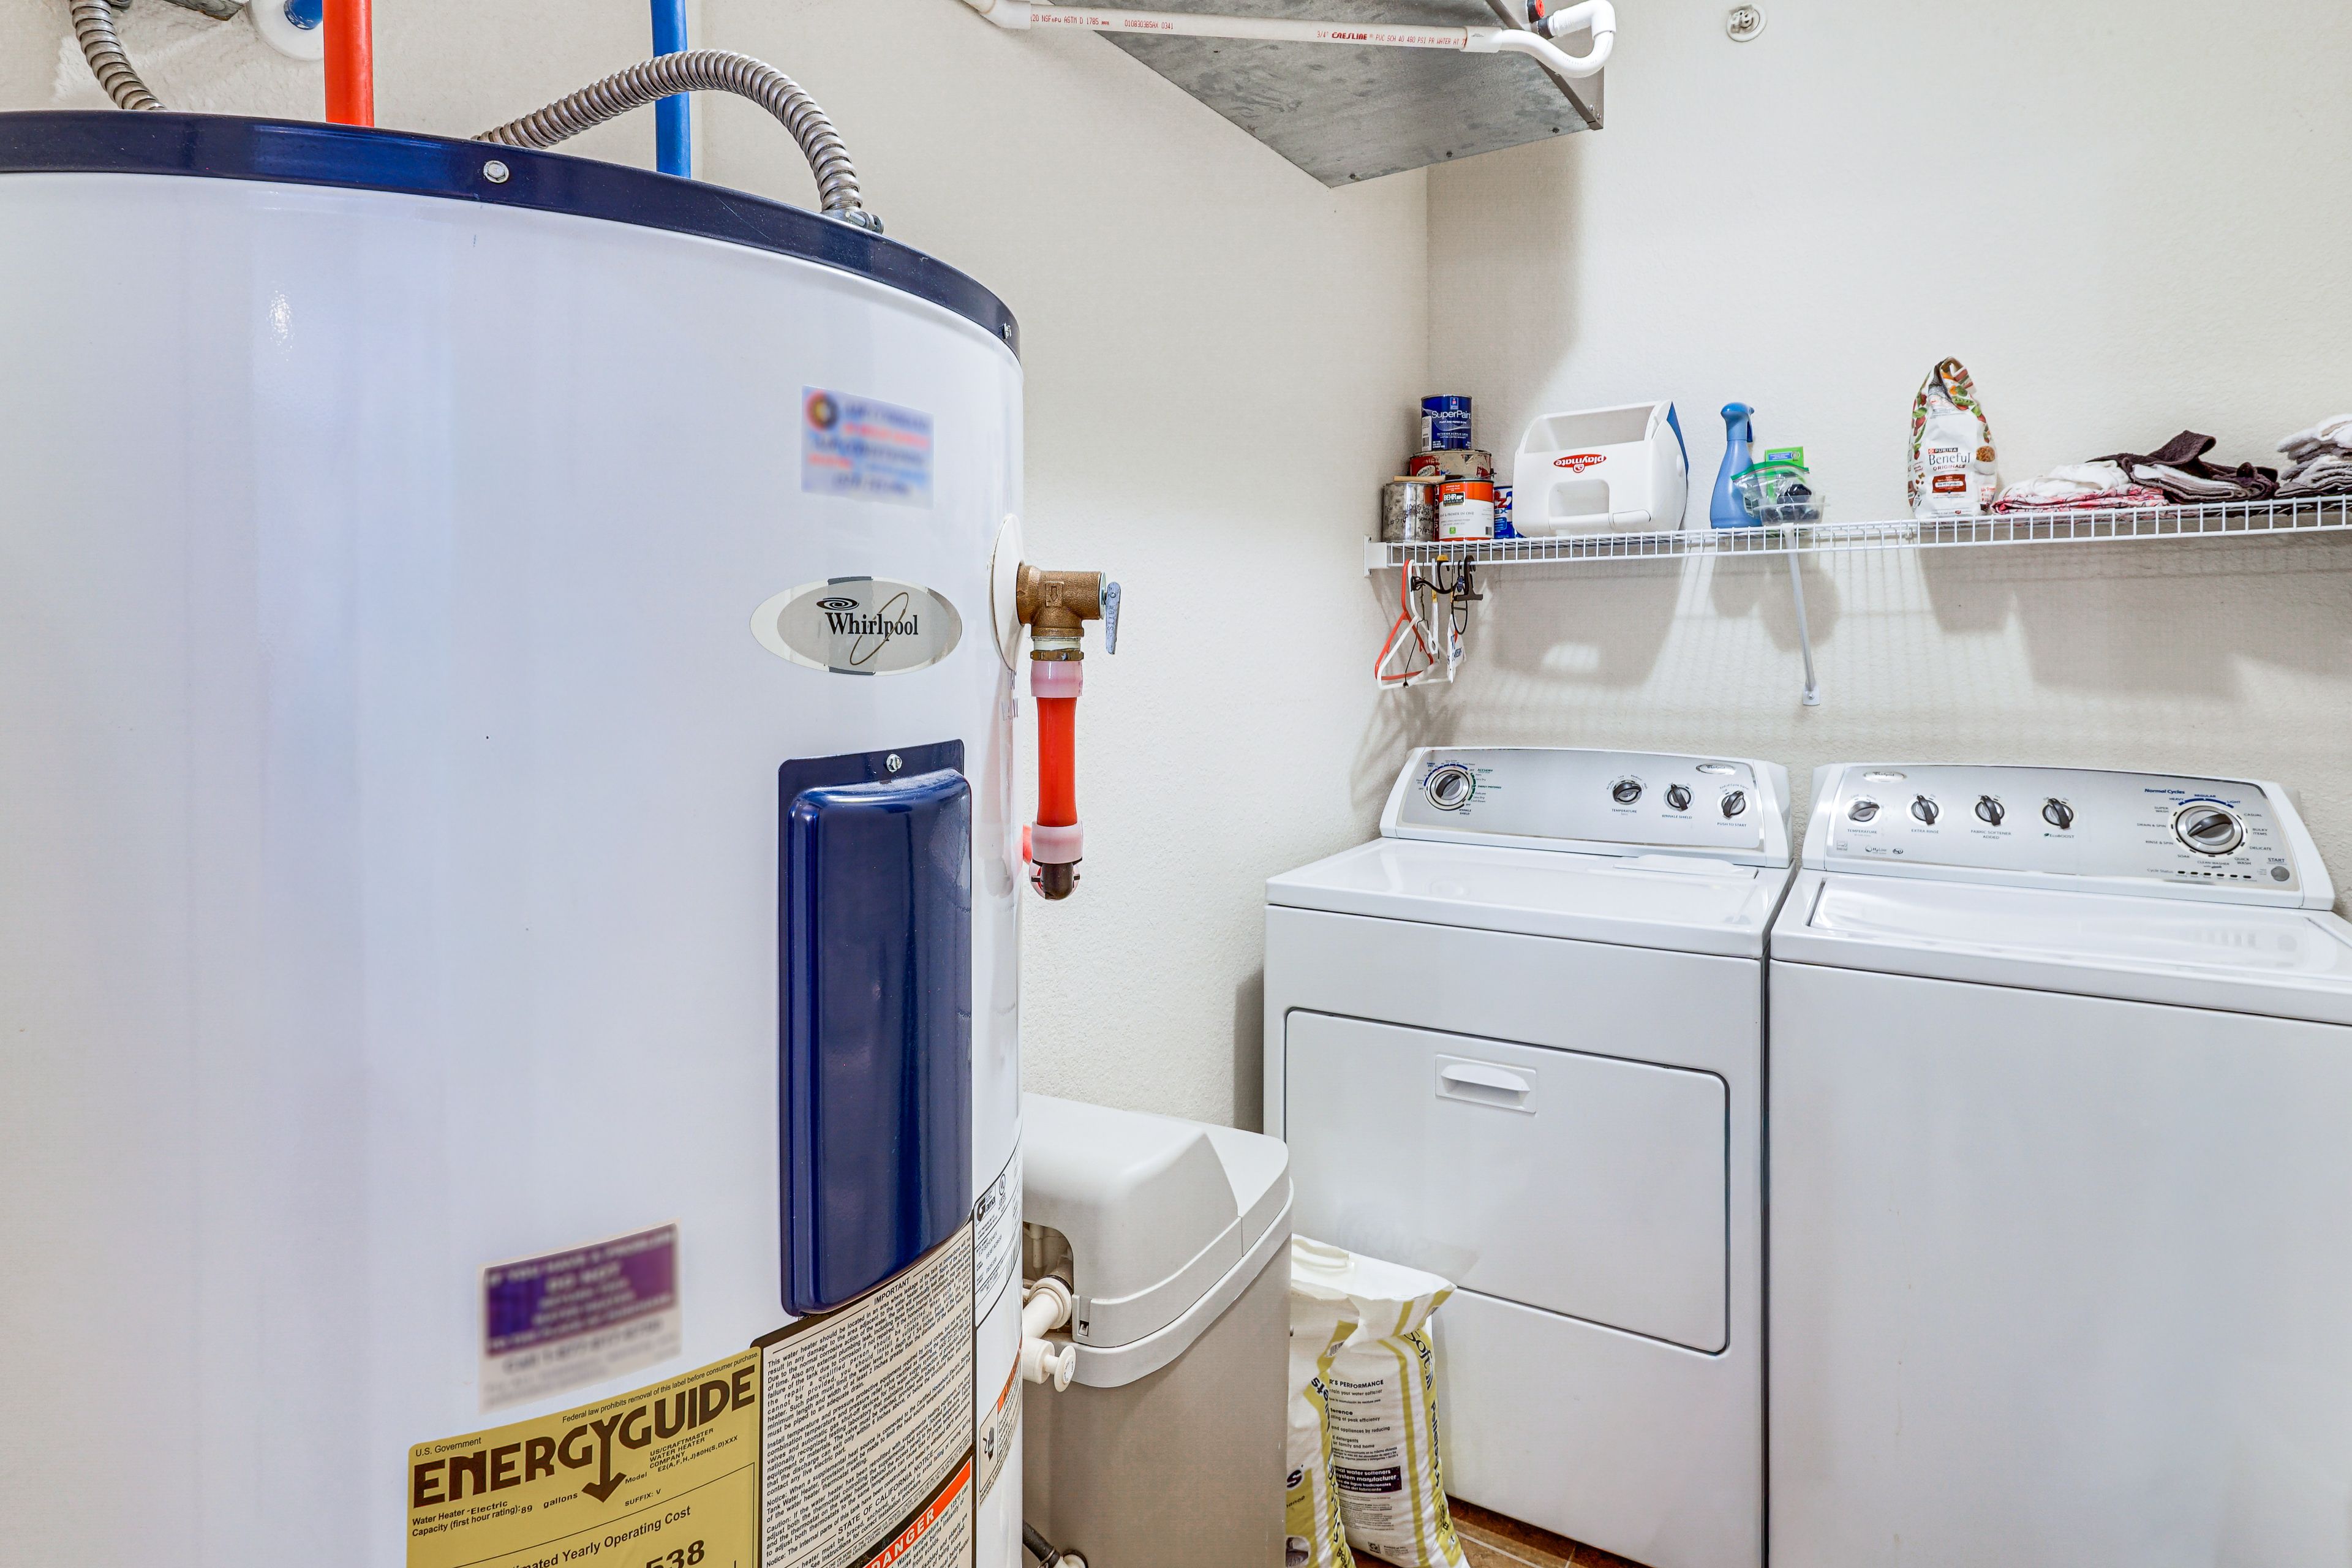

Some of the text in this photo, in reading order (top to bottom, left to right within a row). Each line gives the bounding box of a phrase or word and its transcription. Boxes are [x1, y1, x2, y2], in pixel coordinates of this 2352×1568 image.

[1332, 31, 1368, 40] CRESLINE
[1431, 410, 1471, 420] SuperPaint
[1556, 454, 1605, 466] playmate
[1929, 453, 1971, 466] Beneful
[824, 611, 919, 641] Whirlpool
[874, 1276, 910, 1305] IMPORTANT
[767, 1359, 780, 1368] This
[783, 1349, 799, 1362] water
[801, 1340, 818, 1352] heater
[820, 1330, 837, 1344] should
[848, 1316, 865, 1329] located
[880, 1301, 889, 1311] area
[891, 1292, 903, 1303] where
[904, 1281, 918, 1294] leakage
[767, 1363, 785, 1376] result
[794, 1354, 805, 1364] any
[807, 1343, 827, 1357] damage
[837, 1333, 845, 1342] the
[847, 1327, 858, 1336] area
[859, 1314, 879, 1329] adjacent
[562, 1351, 760, 1423] Federal law prohibits removal of this label before consumer purchase.
[1340, 1379, 1384, 1389] PERFORMANCE
[767, 1427, 782, 1438] must
[793, 1412, 809, 1426] piped
[826, 1390, 849, 1408] adequate
[851, 1381, 864, 1393] drain.
[413, 1364, 755, 1509] ENERGYGUIDE
[415, 1436, 482, 1457] U.S. Government
[649, 1437, 706, 1463] WATER HEATER
[650, 1428, 714, 1457] US/CRAFTMASTER
[1336, 1434, 1359, 1443] detergents
[649, 1450, 685, 1469] COMPANY
[625, 1471, 647, 1485] Model
[838, 1450, 934, 1535] STATE OF CALIFORNIA NOTICE
[625, 1491, 654, 1507] SUFFIX:
[412, 1492, 579, 1537] Capacity (first hour rating): 89 gallons
[412, 1514, 437, 1526] Water
[438, 1509, 465, 1521] Heater
[562, 1542, 601, 1562] Yearly
[604, 1518, 662, 1548] Operating
[665, 1505, 691, 1525] Cost
[870, 1508, 935, 1568] DANGER
[913, 1521, 940, 1552] temperature
